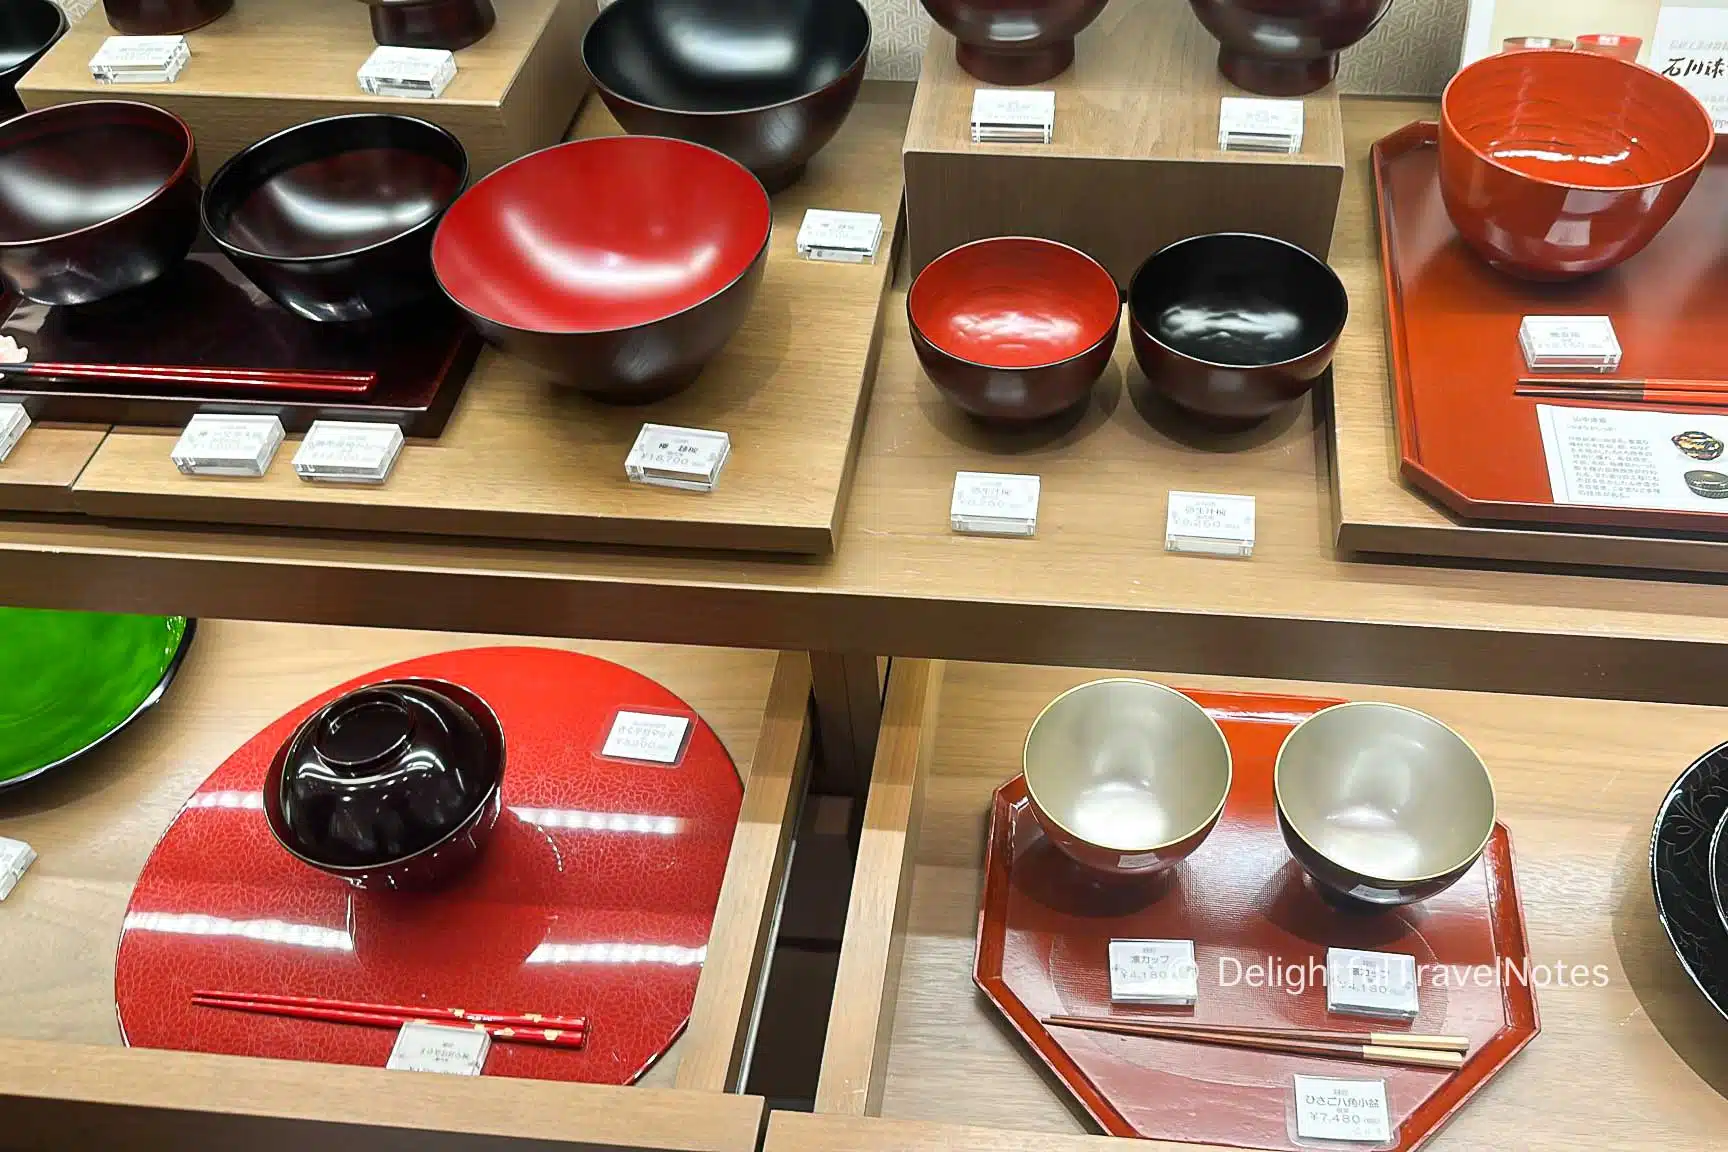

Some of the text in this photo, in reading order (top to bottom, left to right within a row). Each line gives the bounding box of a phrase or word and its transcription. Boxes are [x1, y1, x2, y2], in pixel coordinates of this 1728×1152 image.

[1662, 57, 1728, 79] 石川漆
[1309, 1111, 1361, 1124] ¥7,480
